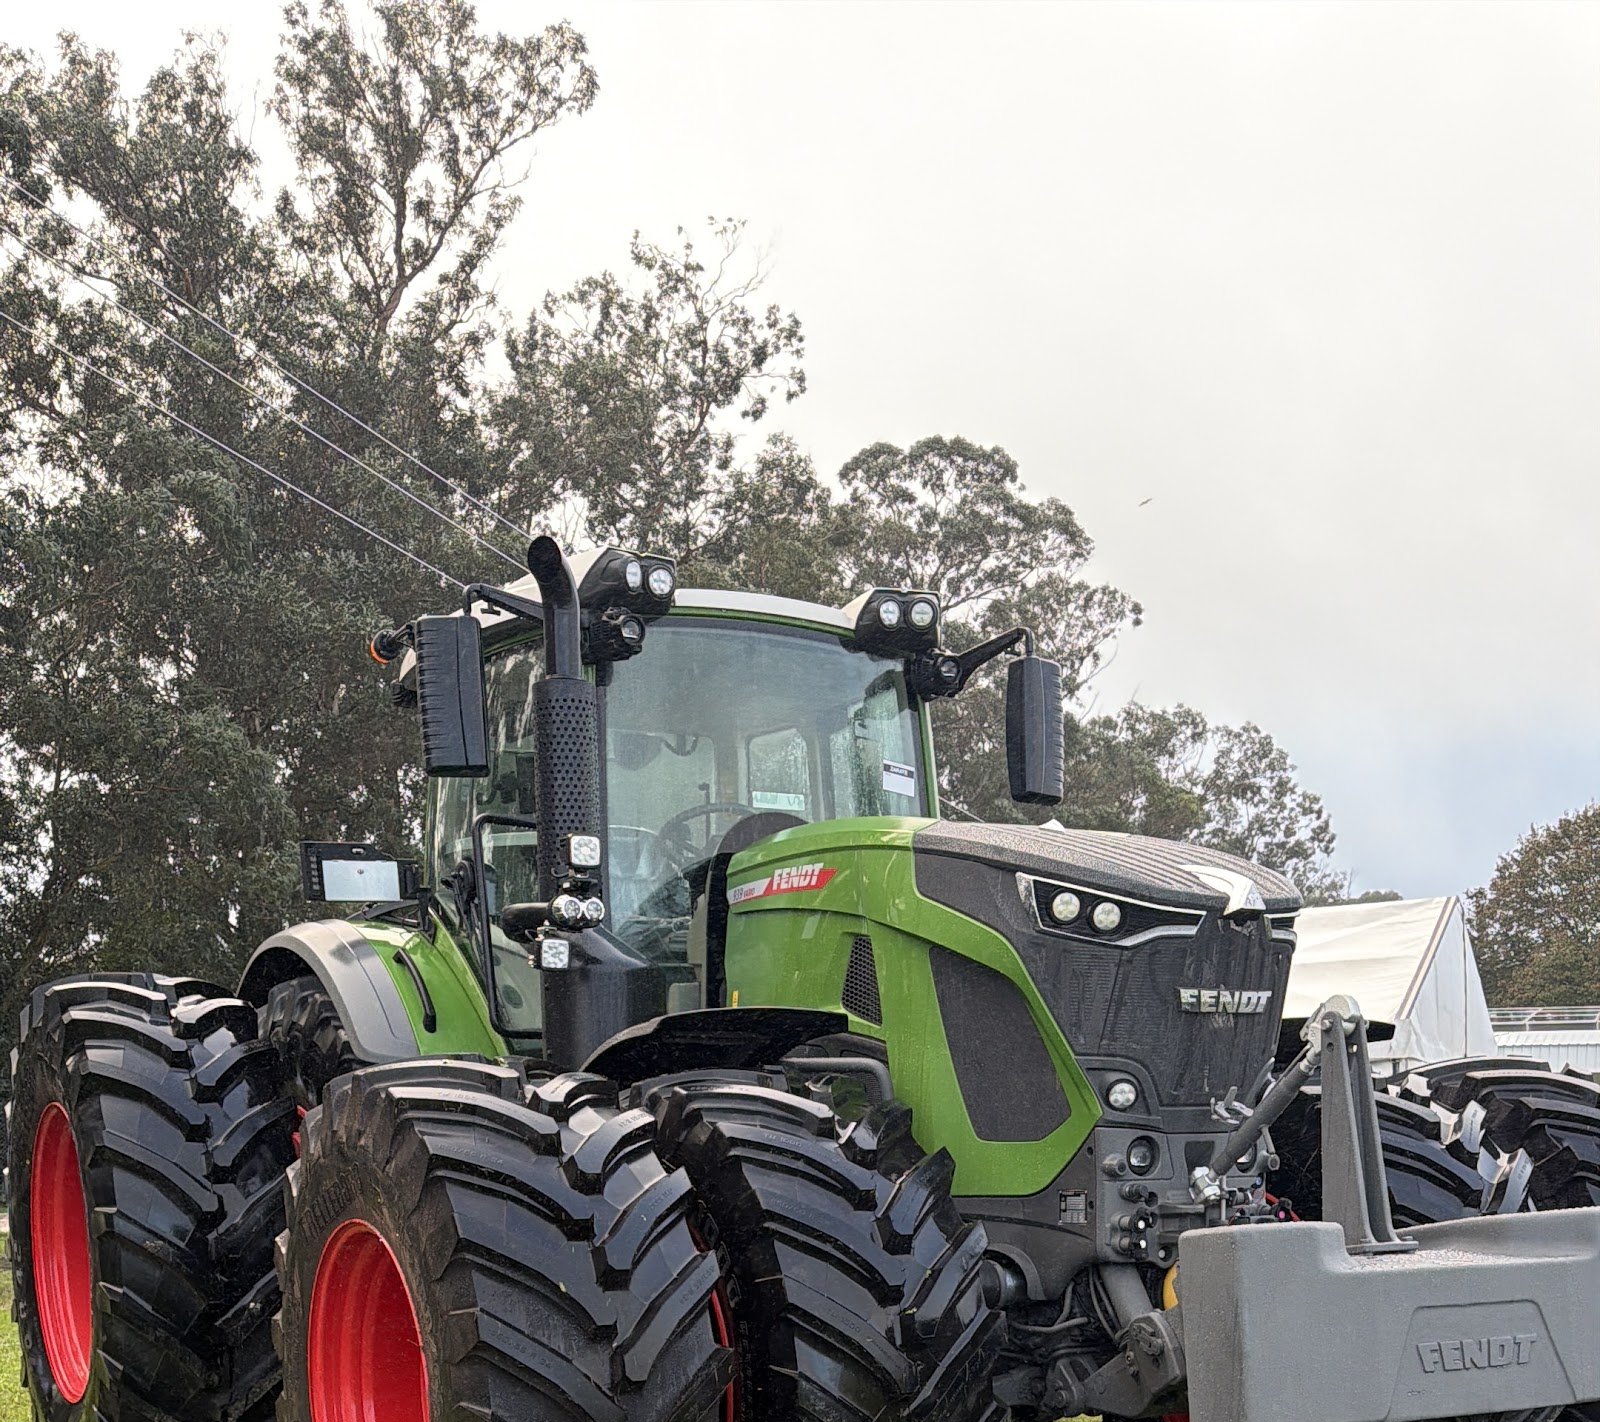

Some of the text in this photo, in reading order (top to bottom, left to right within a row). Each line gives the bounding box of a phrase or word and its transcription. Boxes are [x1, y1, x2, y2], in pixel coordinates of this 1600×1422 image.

[772, 862, 824, 891] FENDT
[1179, 988, 1273, 1014] FENDT
[1416, 1333, 1537, 1374] FENDT
